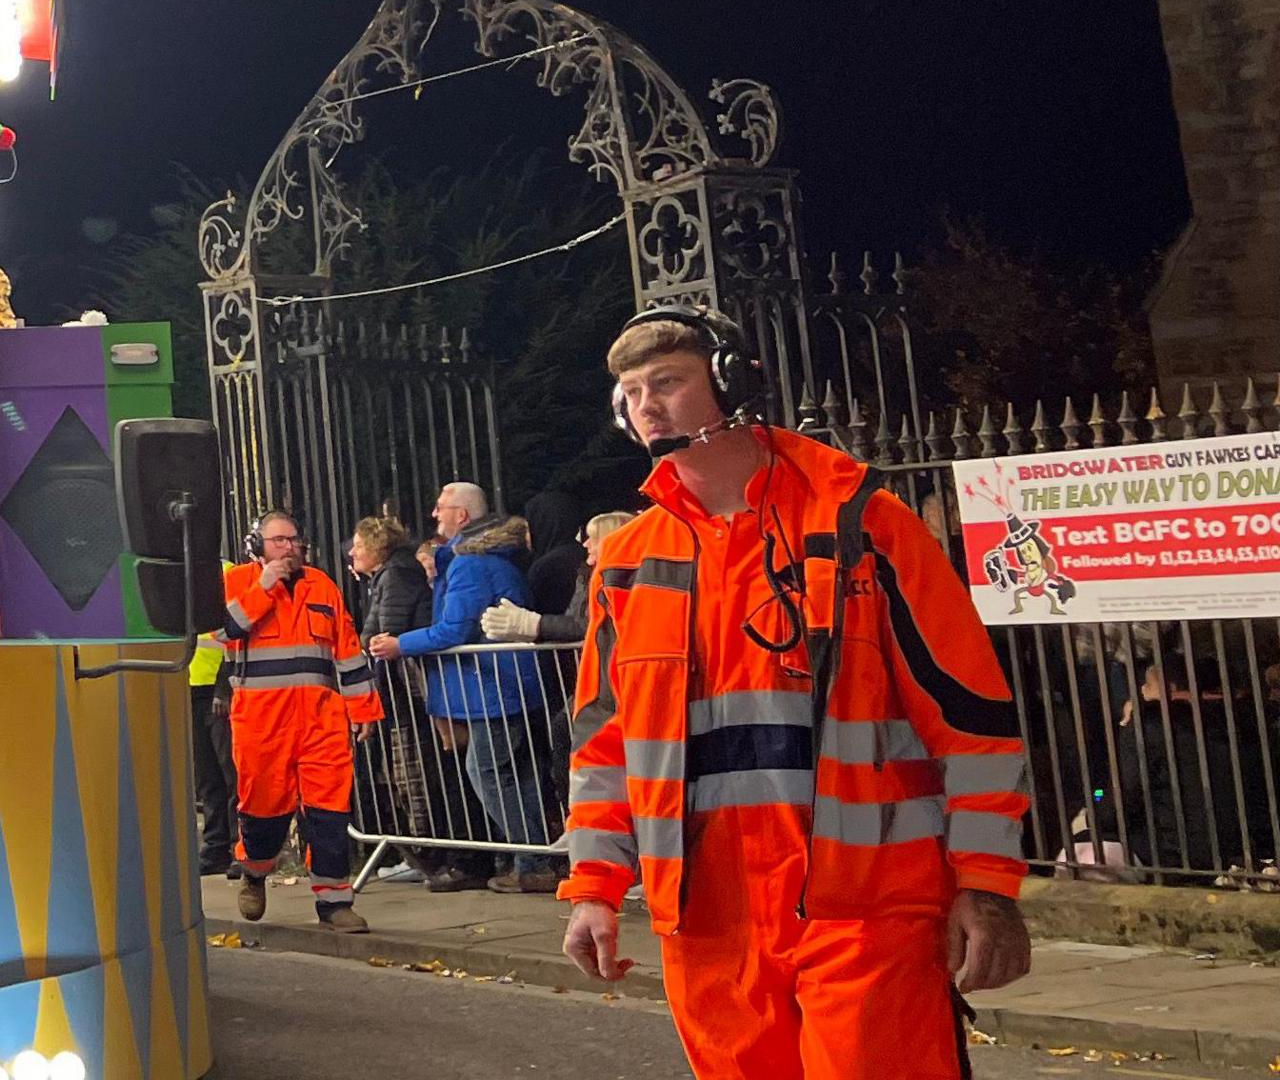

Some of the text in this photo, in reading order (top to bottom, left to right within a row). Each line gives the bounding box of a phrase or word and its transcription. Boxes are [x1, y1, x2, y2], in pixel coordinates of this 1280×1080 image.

[1016, 453, 1165, 481] BRIDGWATER
[1165, 451, 1191, 468] GUY
[1196, 446, 1251, 467] FAWKES
[1021, 466, 1280, 512] THE EASY WAY TO DON
[1051, 525, 1109, 547] Text
[1112, 518, 1192, 544] BGFC
[1194, 517, 1227, 538] to
[1062, 552, 1132, 569] Followed
[1134, 551, 1156, 567] by
